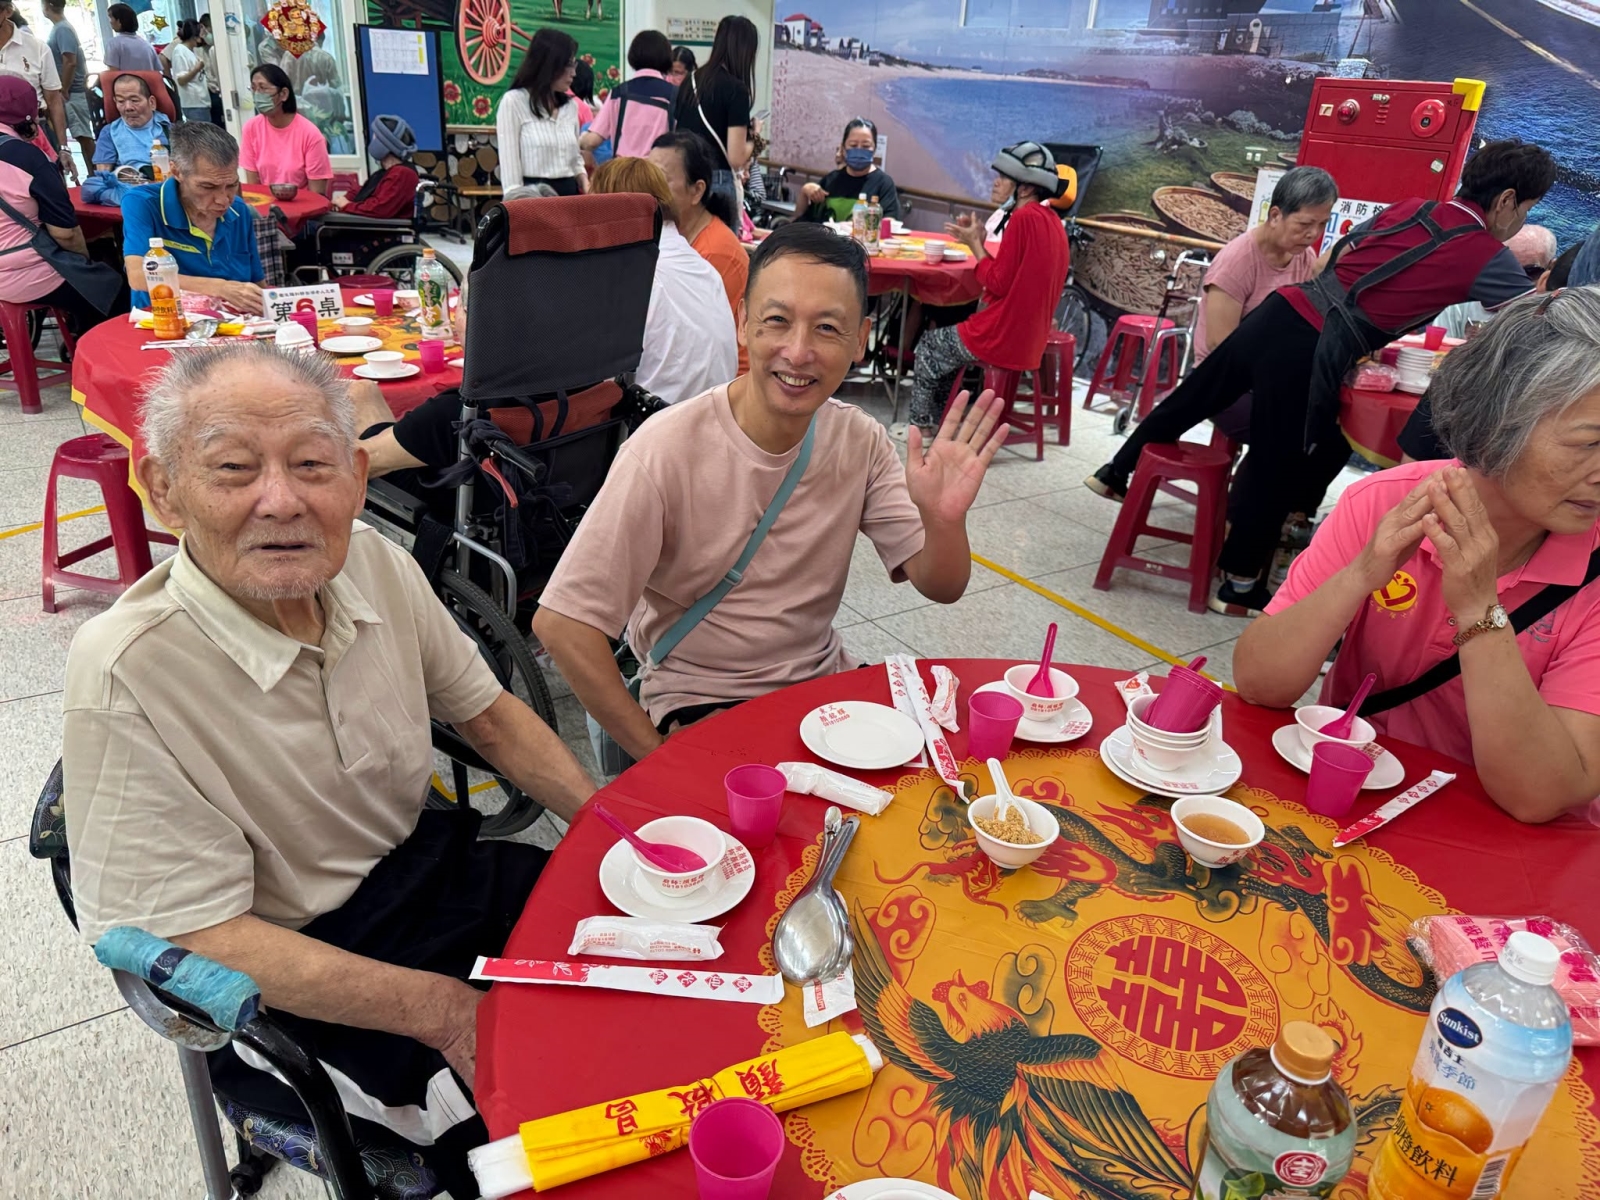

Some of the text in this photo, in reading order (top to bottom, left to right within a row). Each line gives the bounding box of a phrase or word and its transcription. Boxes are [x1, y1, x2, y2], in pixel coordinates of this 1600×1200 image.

[270, 297, 340, 322] 第6桌
[1438, 1011, 1481, 1044] Sunkist
[1392, 1113, 1458, 1188] 柳橙飲料
